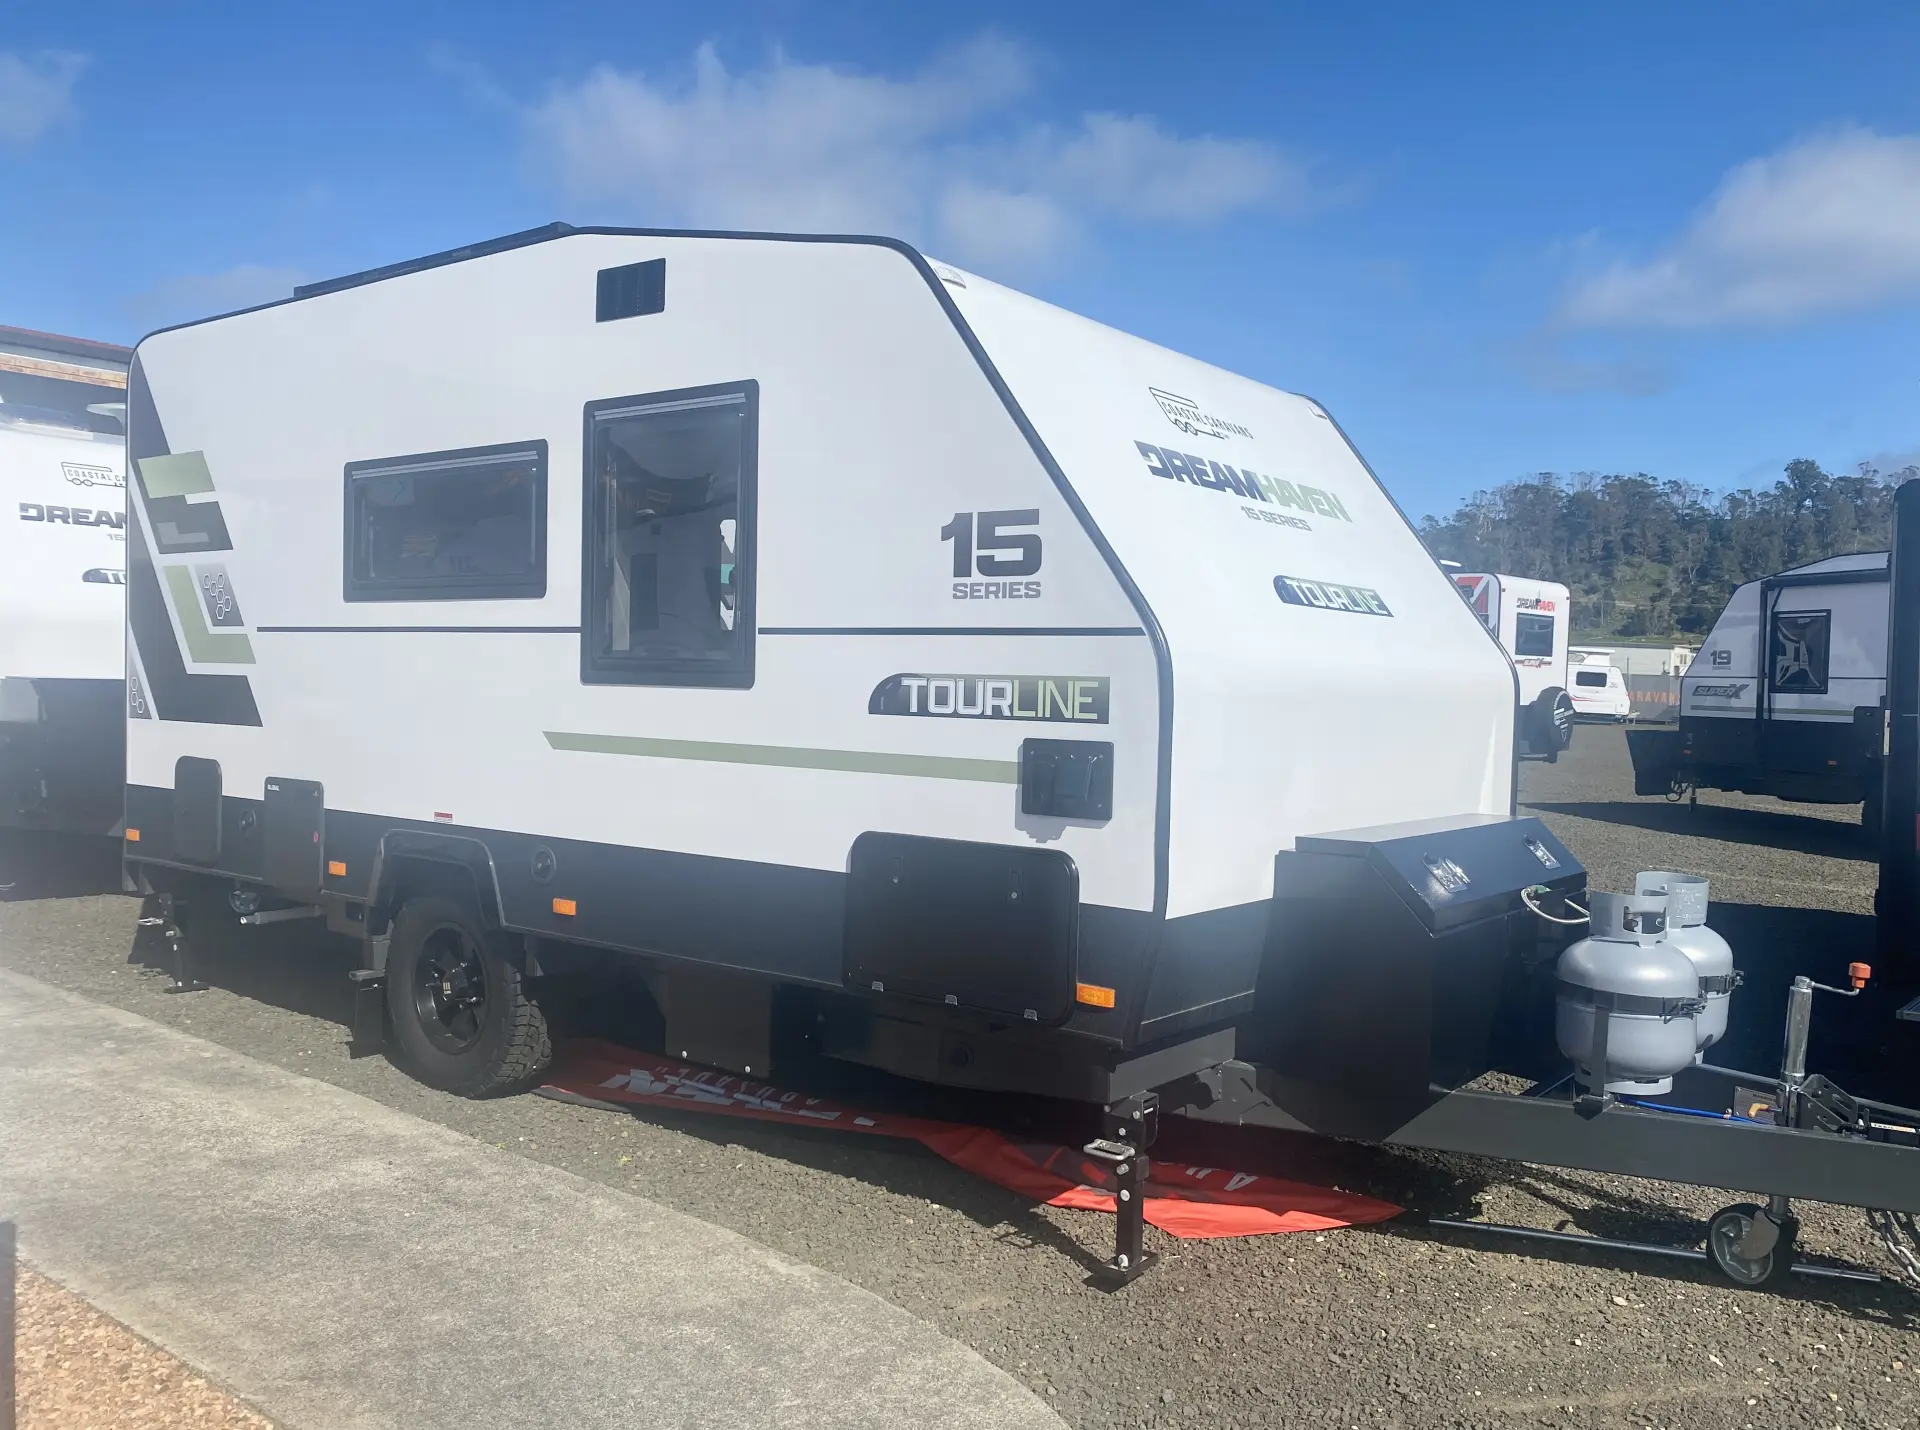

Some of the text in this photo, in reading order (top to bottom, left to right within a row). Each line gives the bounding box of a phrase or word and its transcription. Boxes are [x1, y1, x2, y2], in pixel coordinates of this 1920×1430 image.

[1161, 401, 1254, 439] COASTAL CARAVANS
[66, 468, 112, 481] COASTAL
[1133, 440, 1353, 523] DREAMHAVEN
[1241, 505, 1312, 531] 15 SERIES
[941, 508, 1042, 577] 15
[952, 581, 1042, 600] SERIES
[1282, 577, 1389, 615] TOURLINE
[1710, 650, 1731, 666] 19
[901, 677, 1099, 720] TOURLINE
